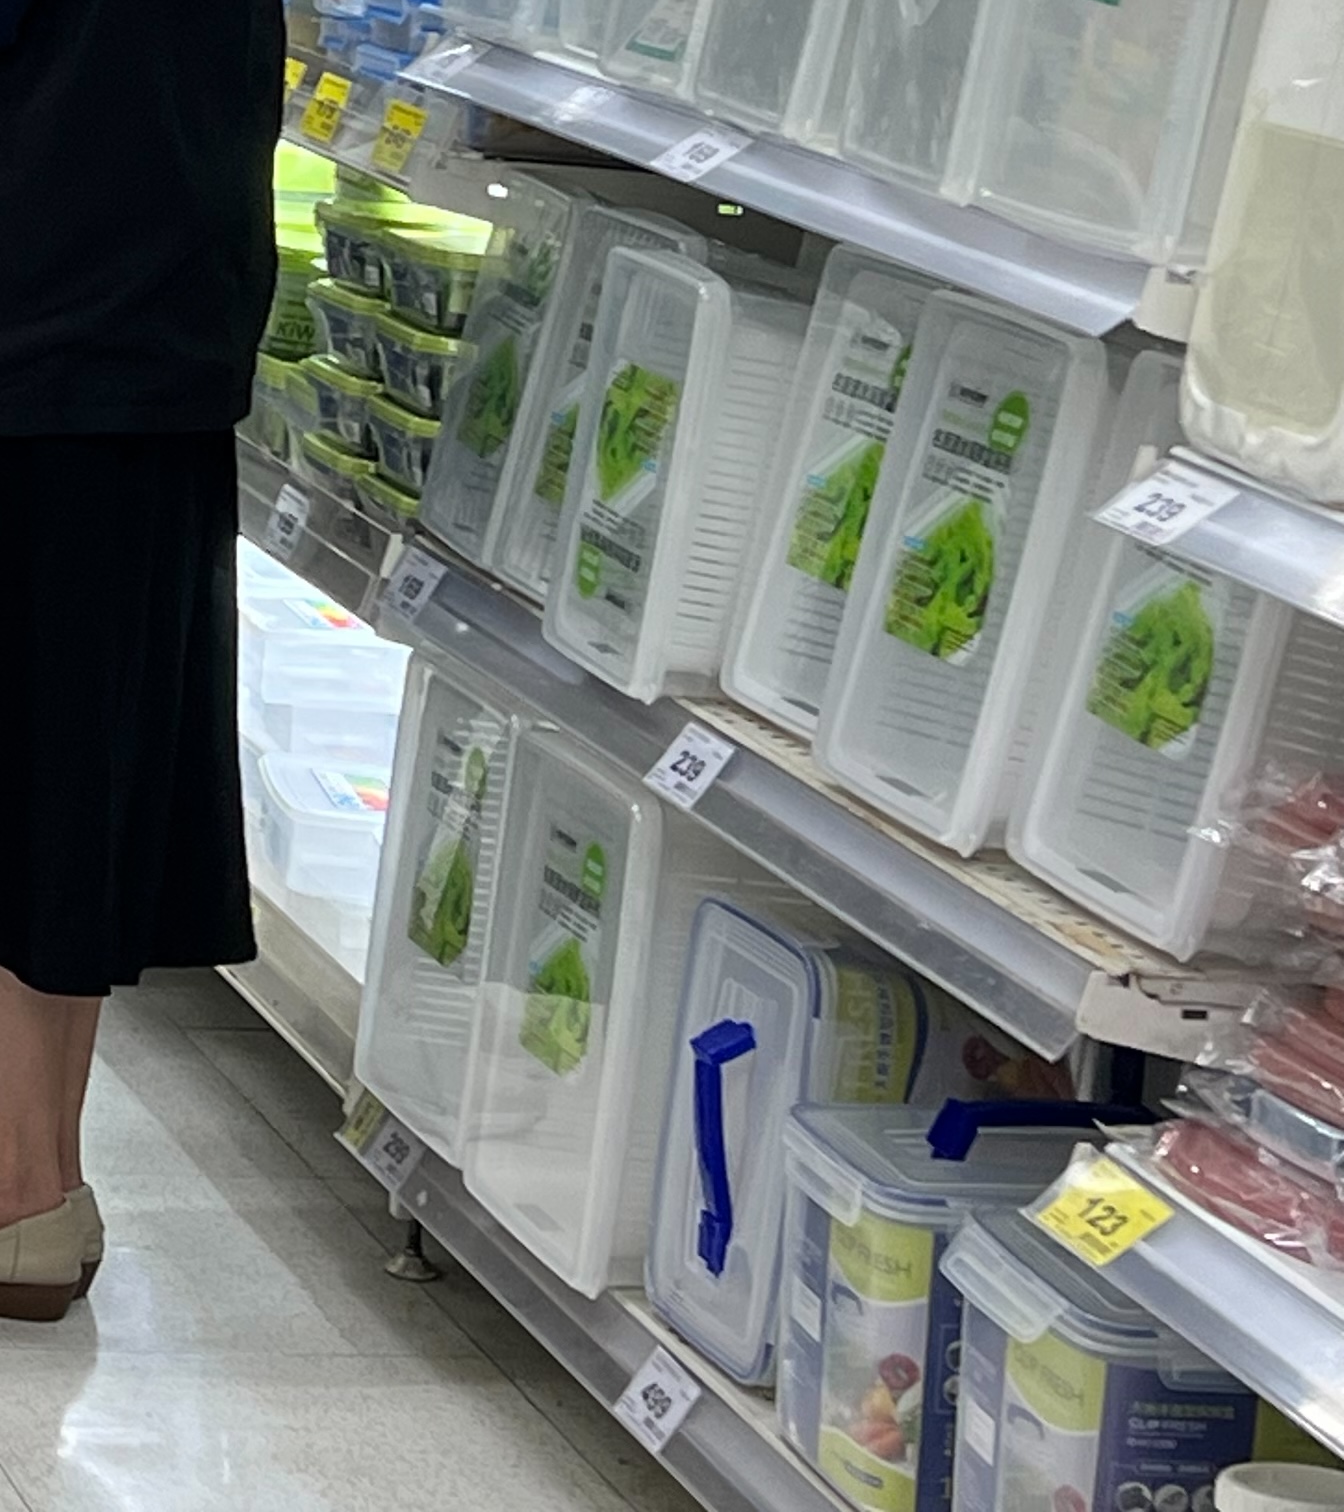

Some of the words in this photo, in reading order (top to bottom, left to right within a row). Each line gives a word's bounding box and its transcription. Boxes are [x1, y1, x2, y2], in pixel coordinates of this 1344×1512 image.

[1134, 492, 1187, 523] 239
[670, 750, 707, 782] 239
[1078, 1197, 1130, 1237] 123
